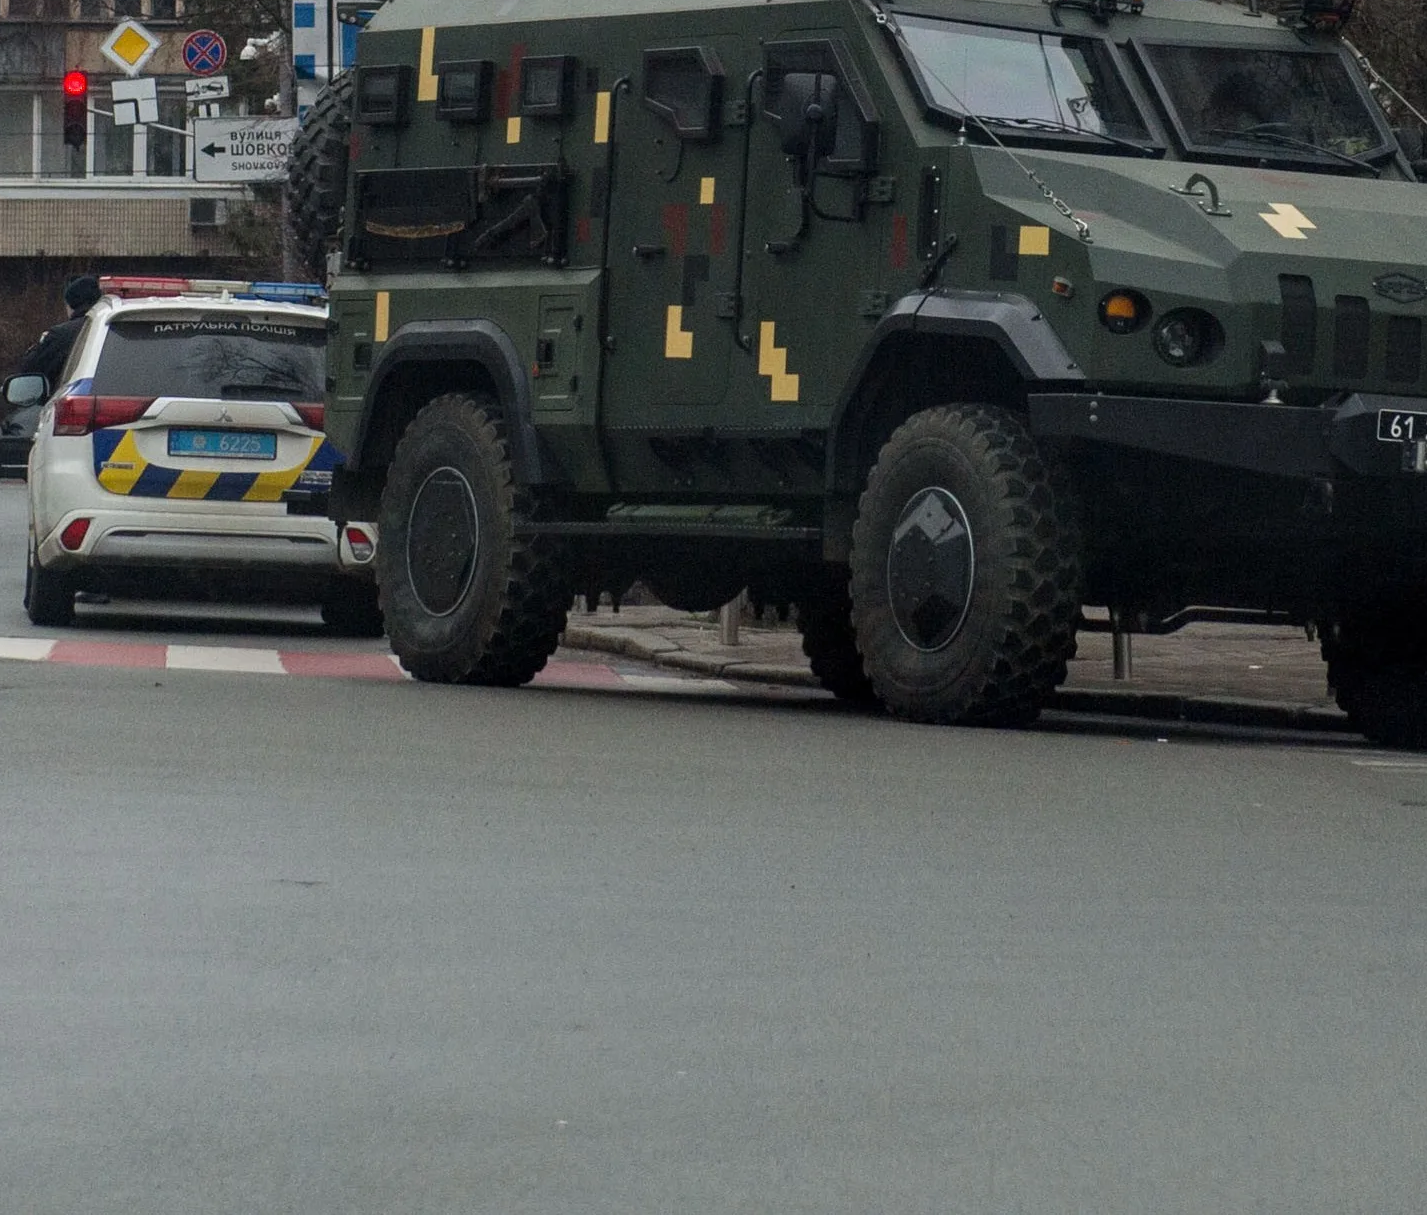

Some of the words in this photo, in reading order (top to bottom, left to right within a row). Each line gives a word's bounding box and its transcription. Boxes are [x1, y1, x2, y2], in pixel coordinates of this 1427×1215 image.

[230, 130, 282, 143] вулиця
[154, 322, 238, 333] ПАТРУЛЬНА
[240, 323, 297, 336] ПОЛІЦІЯ
[1390, 414, 1414, 440] 61
[219, 434, 261, 452] 6225
